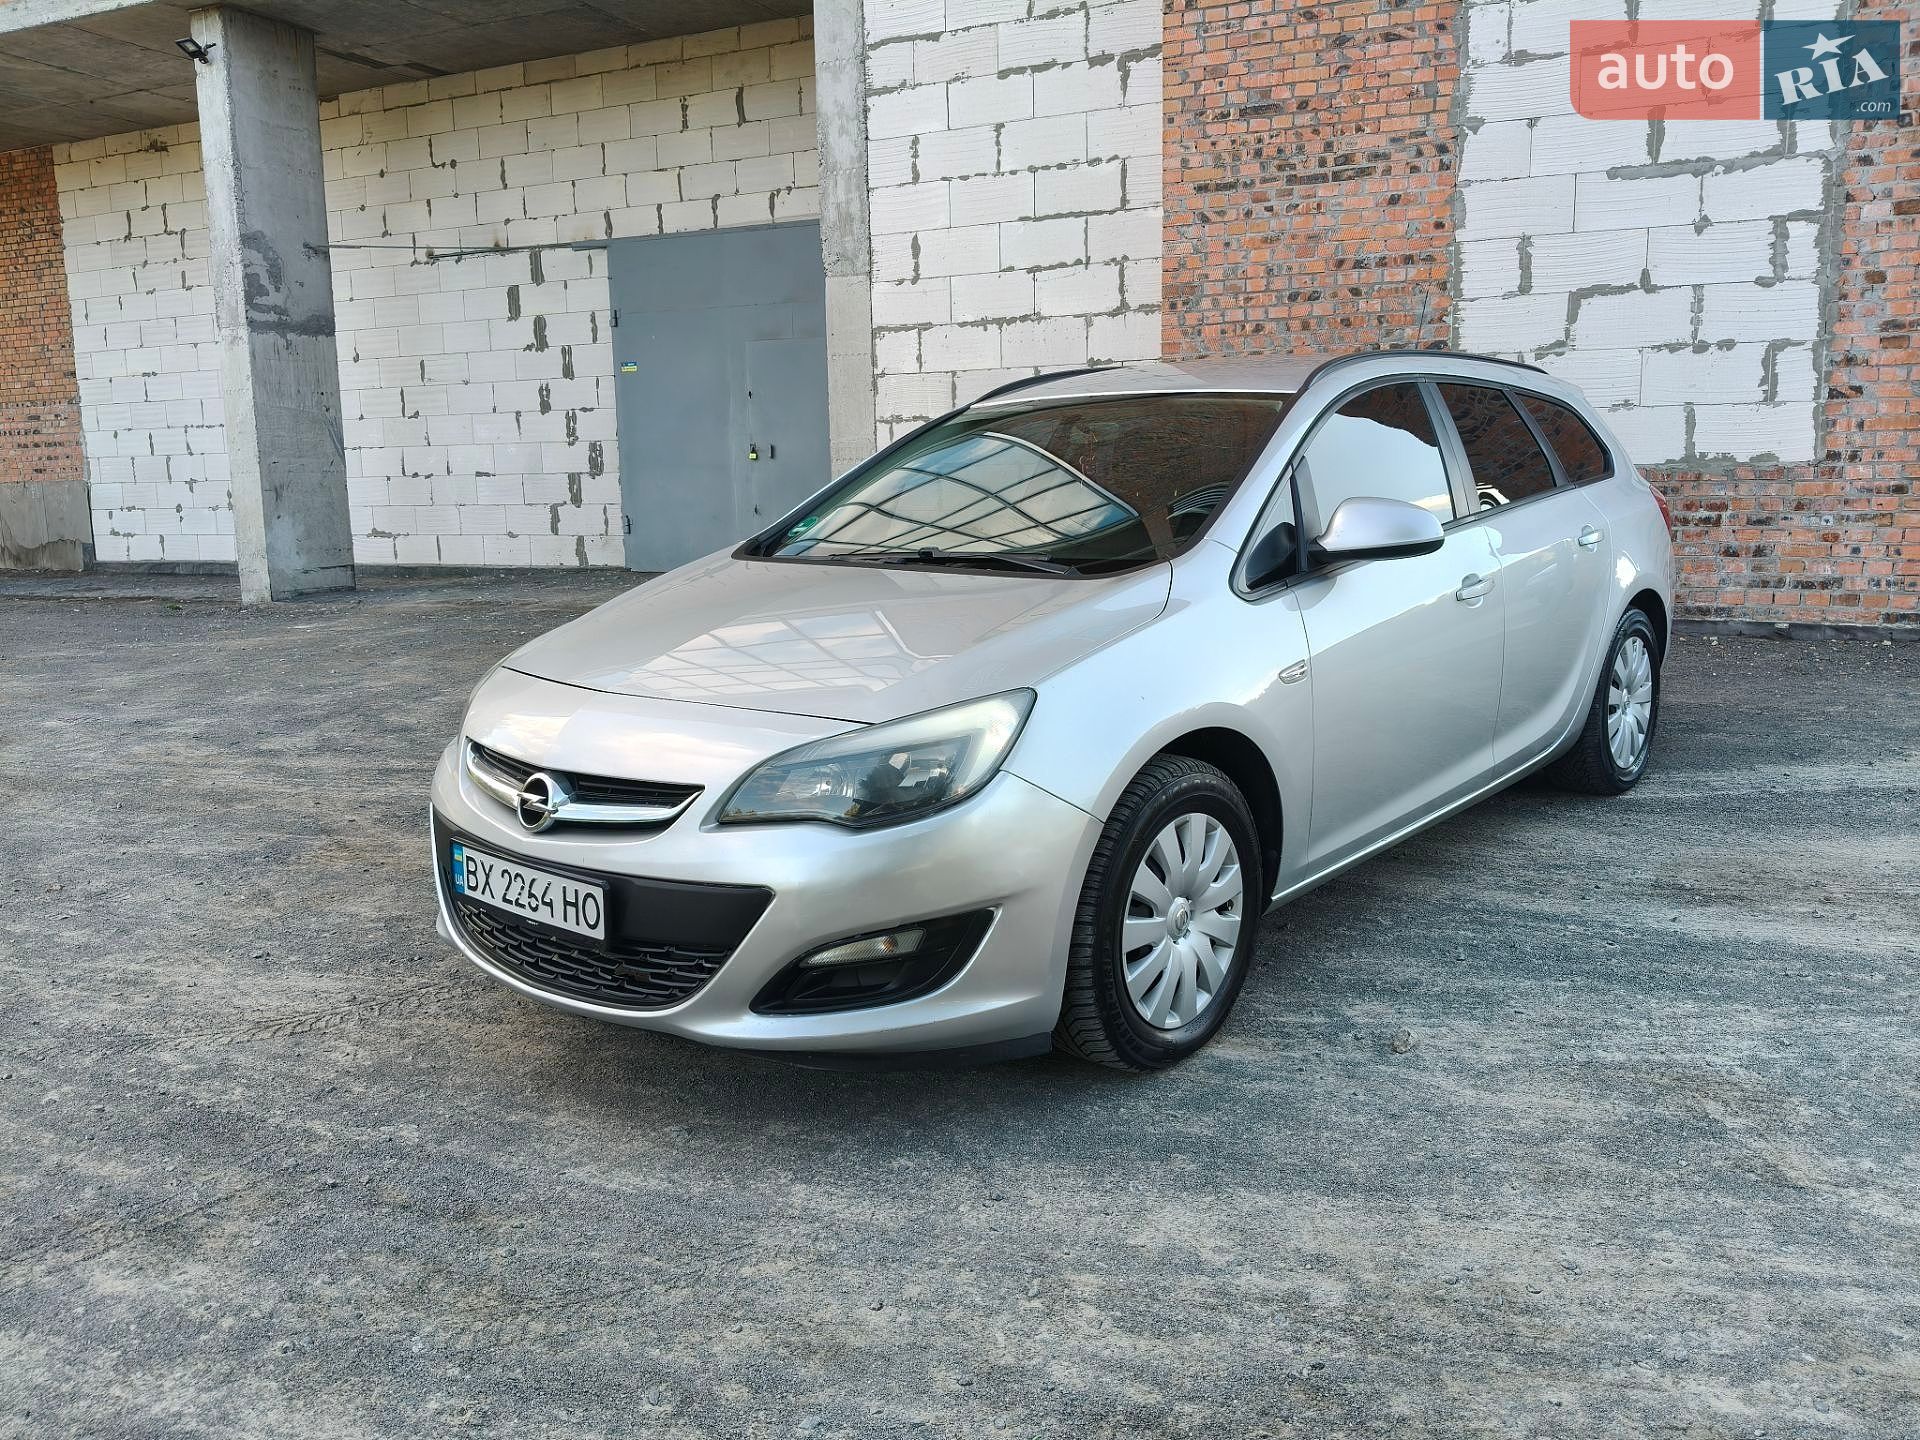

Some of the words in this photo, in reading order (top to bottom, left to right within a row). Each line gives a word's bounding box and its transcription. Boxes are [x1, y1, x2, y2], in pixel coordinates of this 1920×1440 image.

[455, 874, 464, 886] UA
[465, 854, 496, 900] BX
[501, 868, 554, 919] 2264
[562, 885, 601, 931] HO
